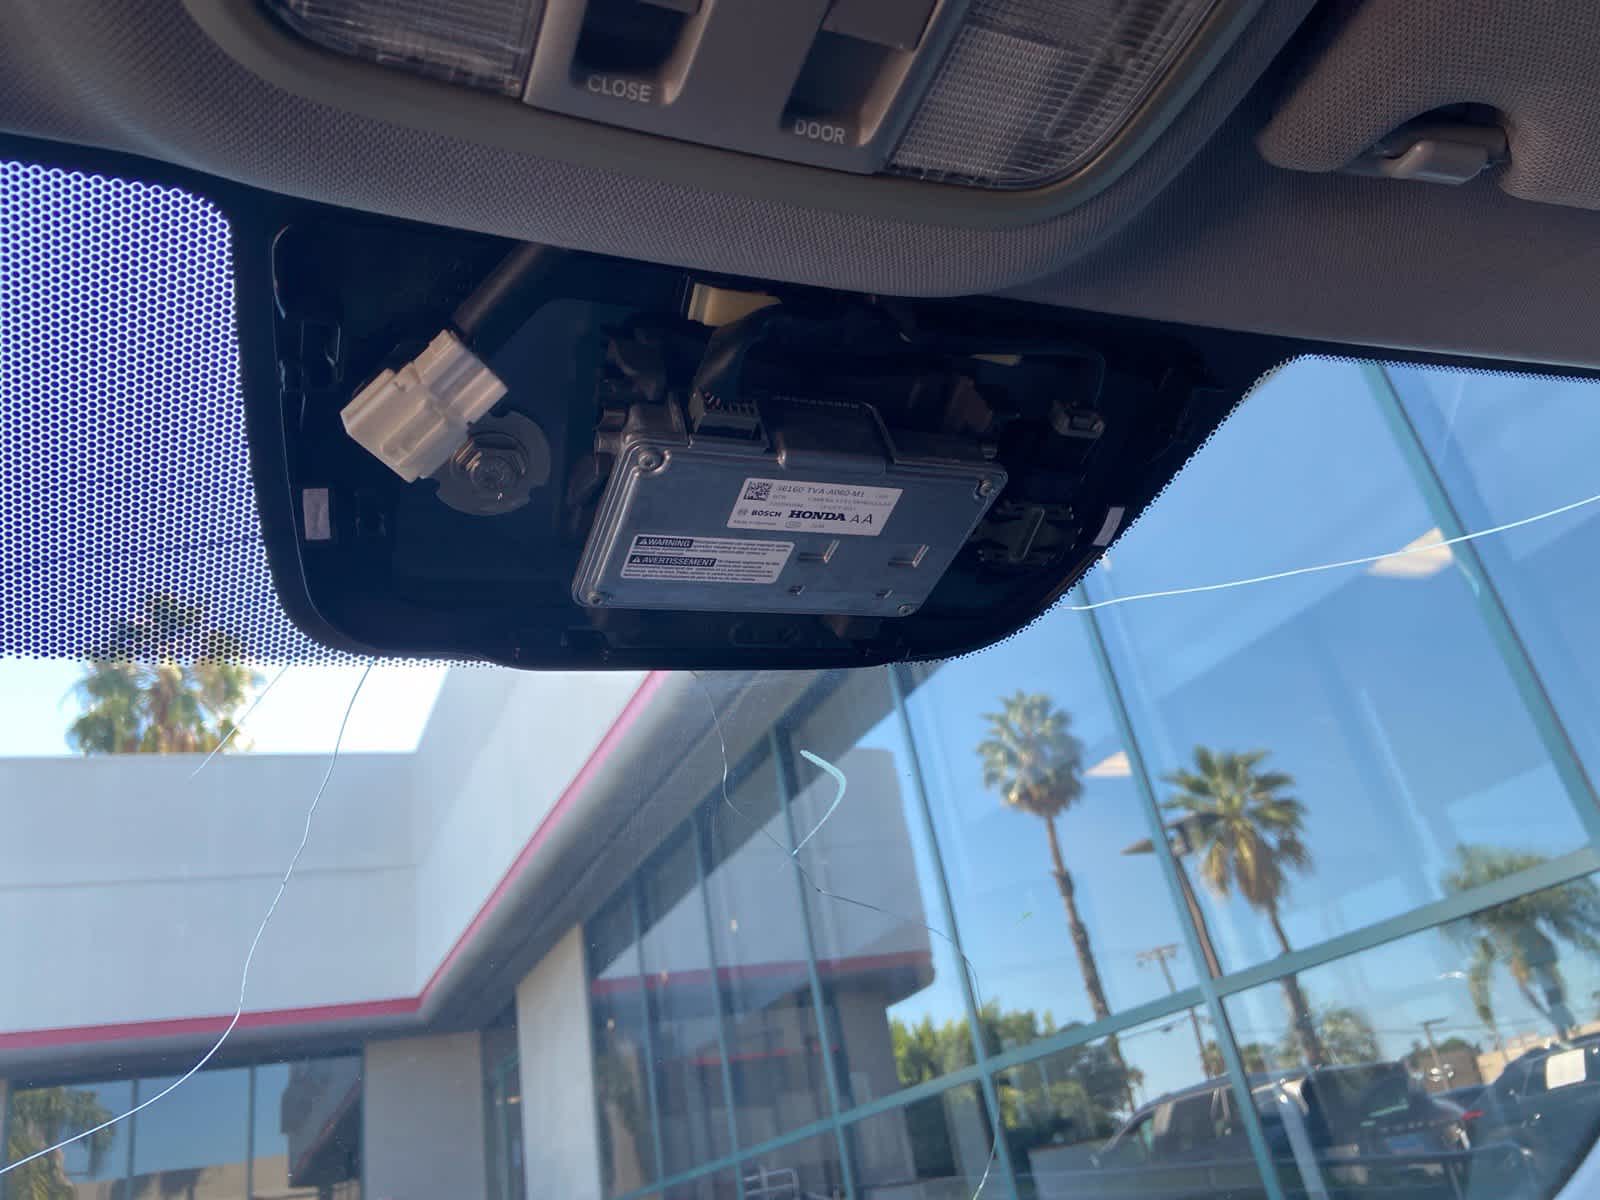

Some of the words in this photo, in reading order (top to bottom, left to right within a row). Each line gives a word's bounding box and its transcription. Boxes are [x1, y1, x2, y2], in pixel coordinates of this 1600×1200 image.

[587, 74, 652, 103] CLOSE
[794, 119, 846, 145] DOOR
[751, 510, 782, 518] BOSCH
[788, 509, 846, 522] HONDA
[647, 537, 691, 548] WARNING
[641, 556, 715, 567] AVERTISSEMENT
